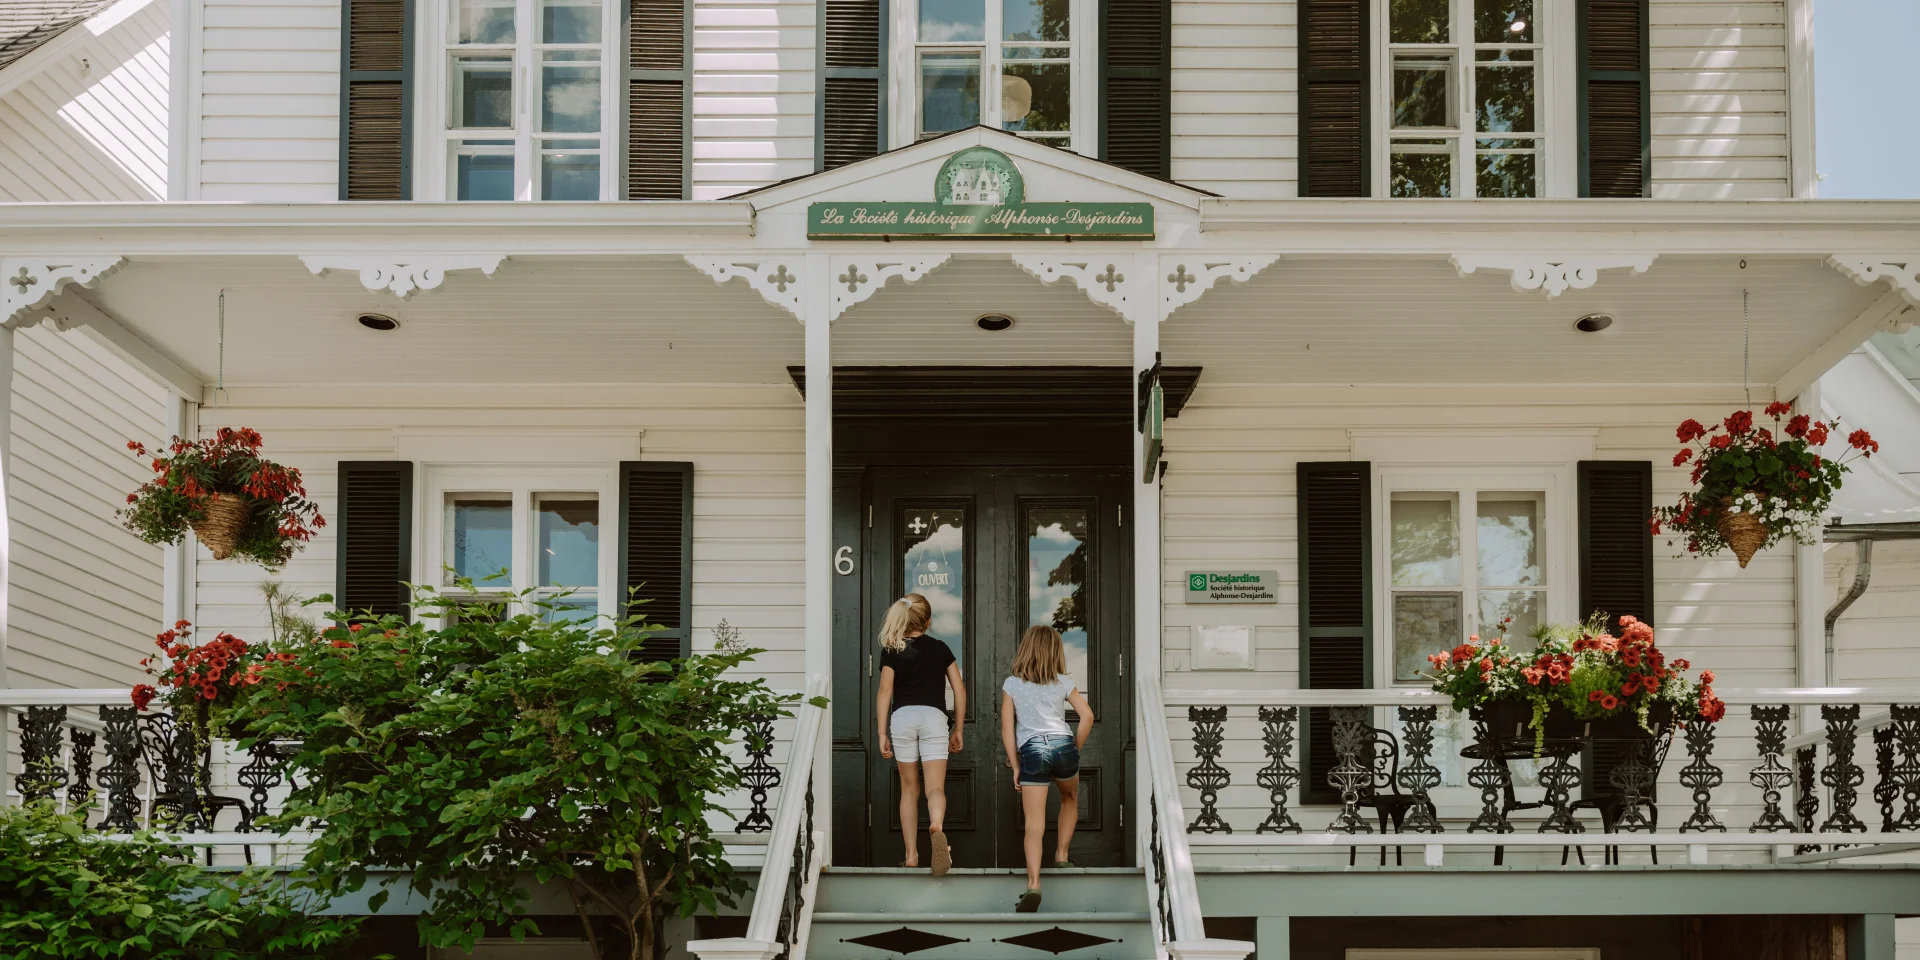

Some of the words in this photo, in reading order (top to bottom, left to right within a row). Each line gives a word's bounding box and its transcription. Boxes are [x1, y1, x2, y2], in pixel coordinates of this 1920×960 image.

[820, 208, 845, 225] La
[850, 208, 899, 225] Société
[904, 208, 976, 230] historique
[984, 208, 1144, 230] Alphonse-Desjardins
[834, 545, 855, 576] 6
[918, 573, 949, 586] OUVERT
[1209, 573, 1261, 585] Desjardins
[1209, 584, 1233, 592] Société
[1233, 584, 1266, 593] historique
[1209, 592, 1274, 601] Alphonse-Desjardins
